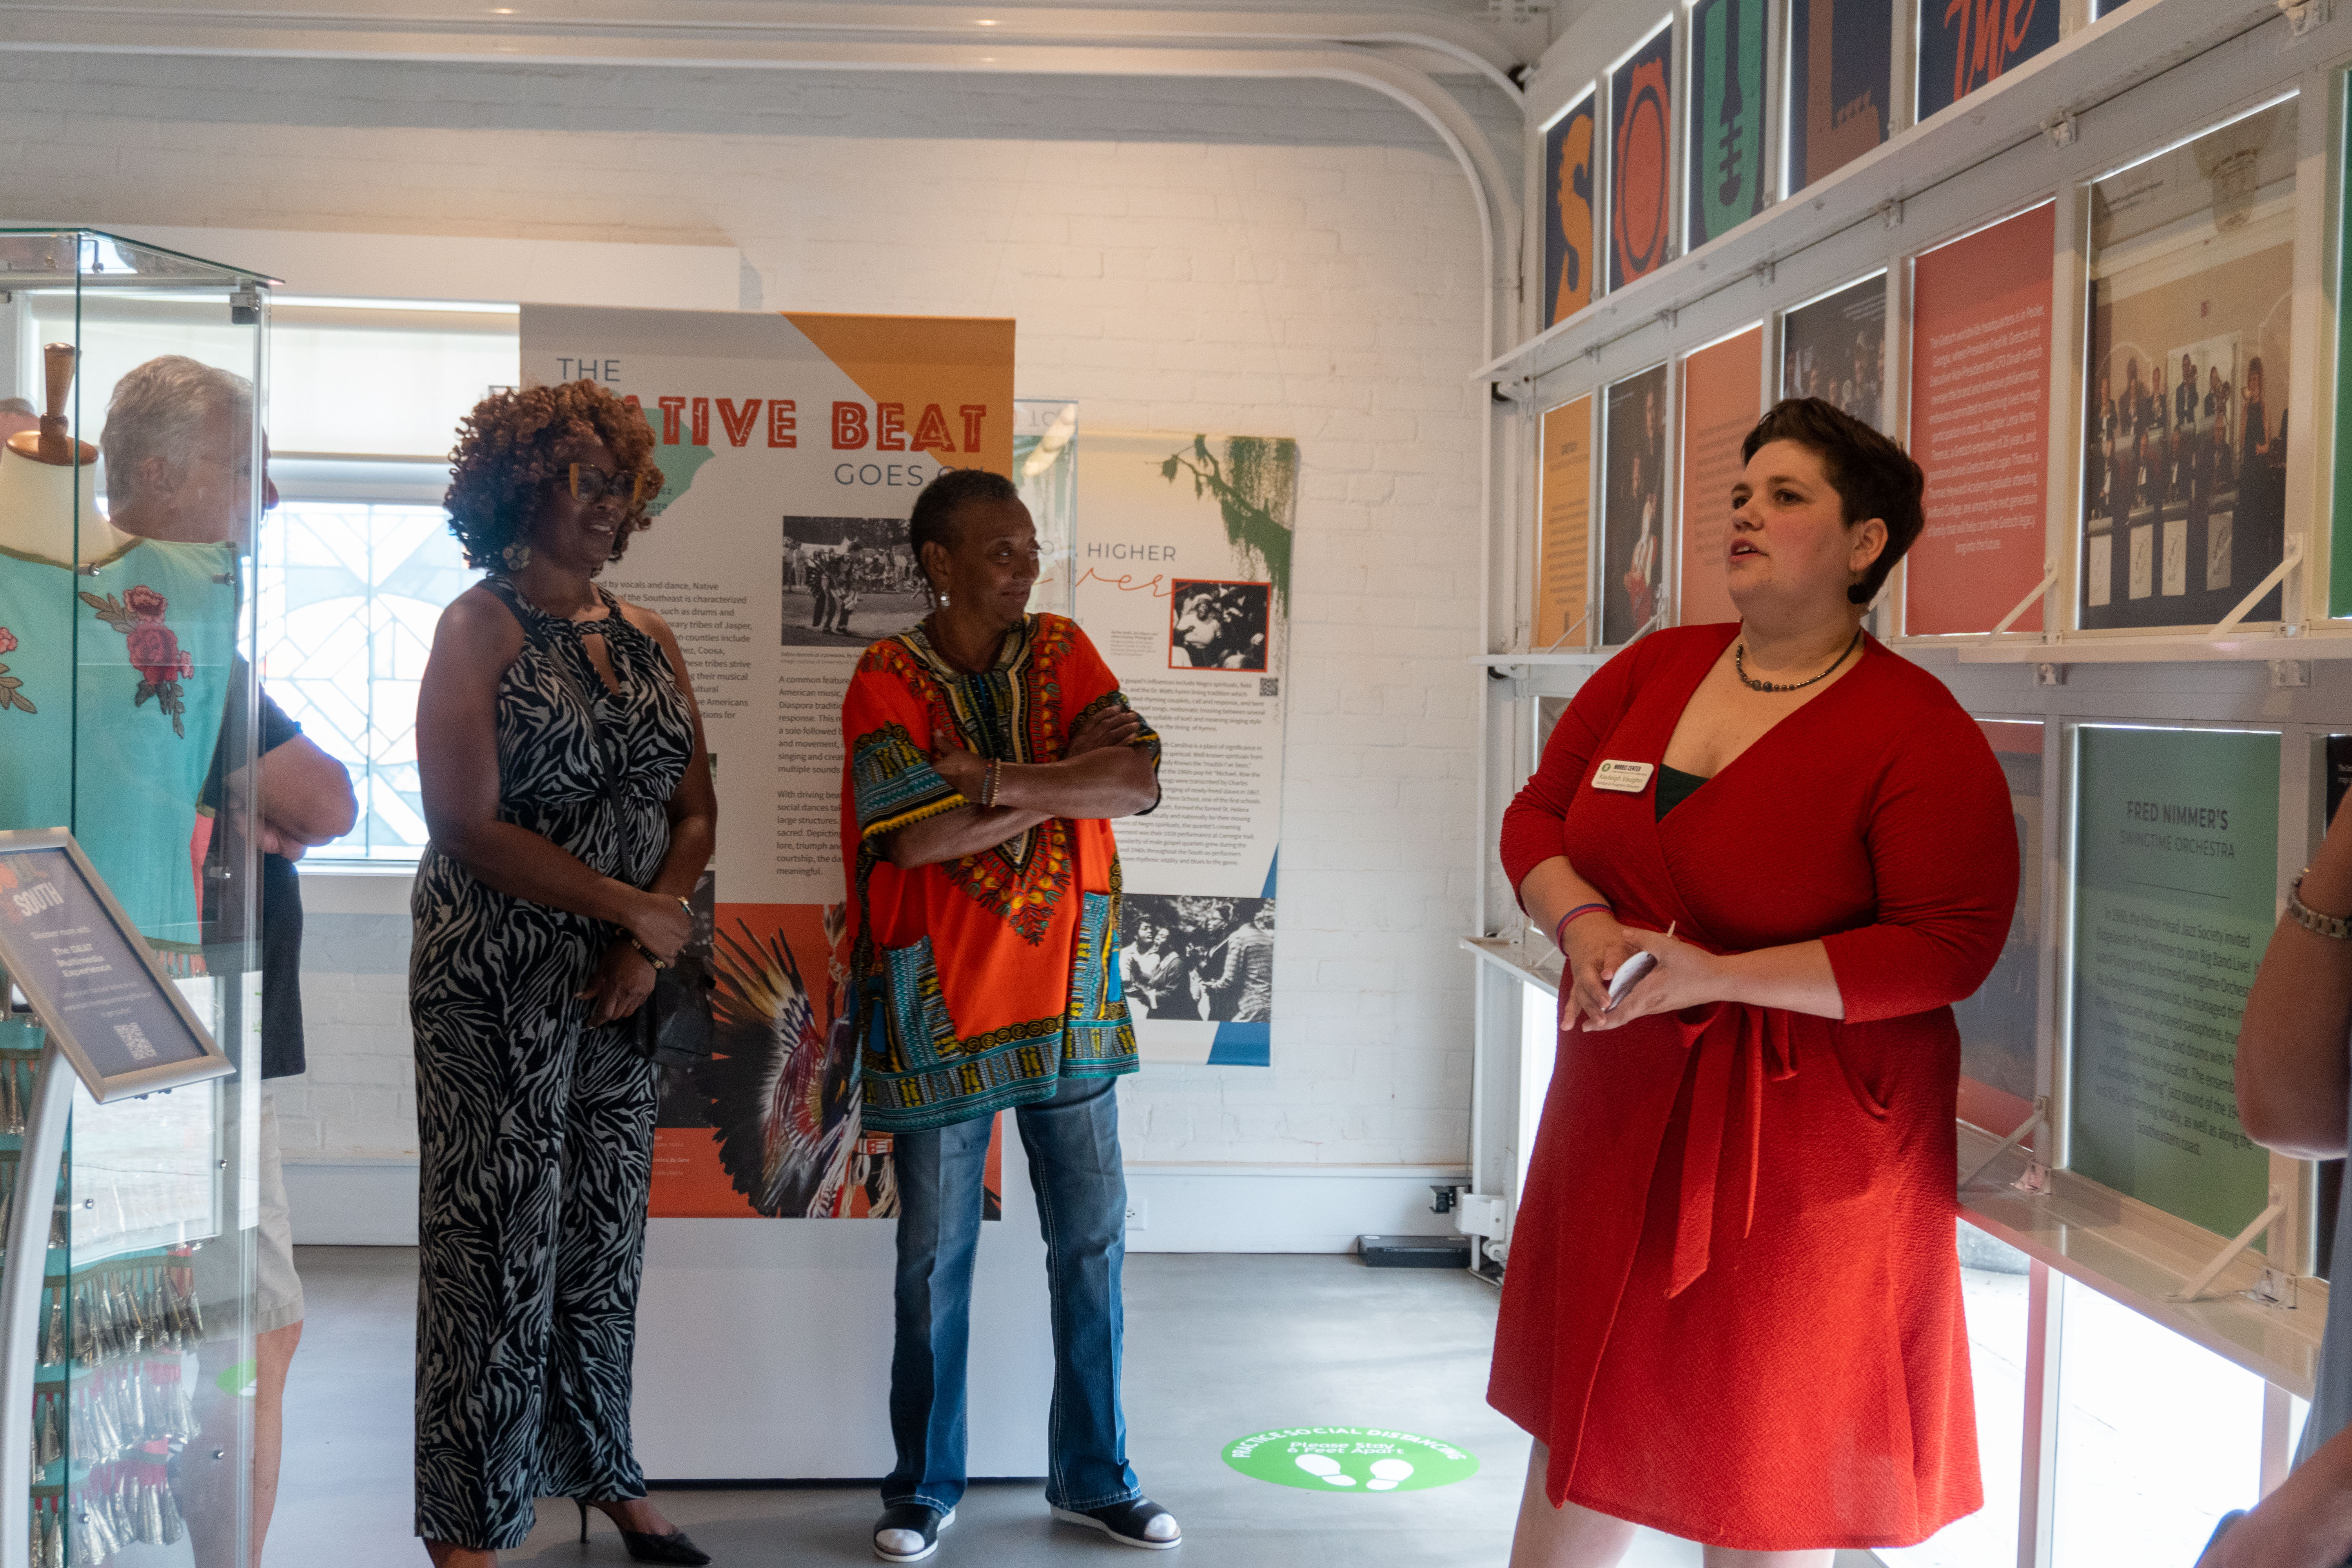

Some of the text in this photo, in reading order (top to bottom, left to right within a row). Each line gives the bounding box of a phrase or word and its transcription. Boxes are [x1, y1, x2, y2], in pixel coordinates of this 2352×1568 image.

[556, 358, 621, 382] THE
[625, 395, 987, 453] TIVE BEAT
[834, 463, 924, 486] GOES
[1088, 543, 1176, 561] HIGHER
[608, 580, 618, 589] by
[664, 582, 691, 590] dance,
[693, 595, 747, 604] characterized
[724, 622, 752, 631] Jasper,
[698, 647, 725, 656] Coosa,
[779, 701, 813, 711] Diaspora
[778, 753, 806, 762] singing
[778, 765, 811, 774] multiple
[797, 791, 824, 800] driving
[2127, 801, 2229, 831] FRED NIMMER'S
[776, 817, 797, 826] large
[806, 830, 838, 838] Depictin
[776, 842, 794, 850] lore,
[796, 843, 827, 851] triumph
[2120, 829, 2235, 860] SWINGTIME ORCHESTRA
[776, 855, 815, 864] courtship,
[776, 868, 822, 877] meaningful.
[13, 882, 64, 917] SOUTH
[2162, 917, 2180, 934] Head
[2181, 920, 2196, 937] Jazz
[2197, 924, 2222, 947] Society
[2224, 930, 2250, 948] invited
[2200, 949, 2212, 969] Big
[2213, 951, 2231, 969] Band
[2221, 977, 2252, 998] Orchest
[1232, 1427, 1467, 1461] PRACTICE SOCIAL DISTANCING
[1356, 1442, 1395, 1451] Stay
